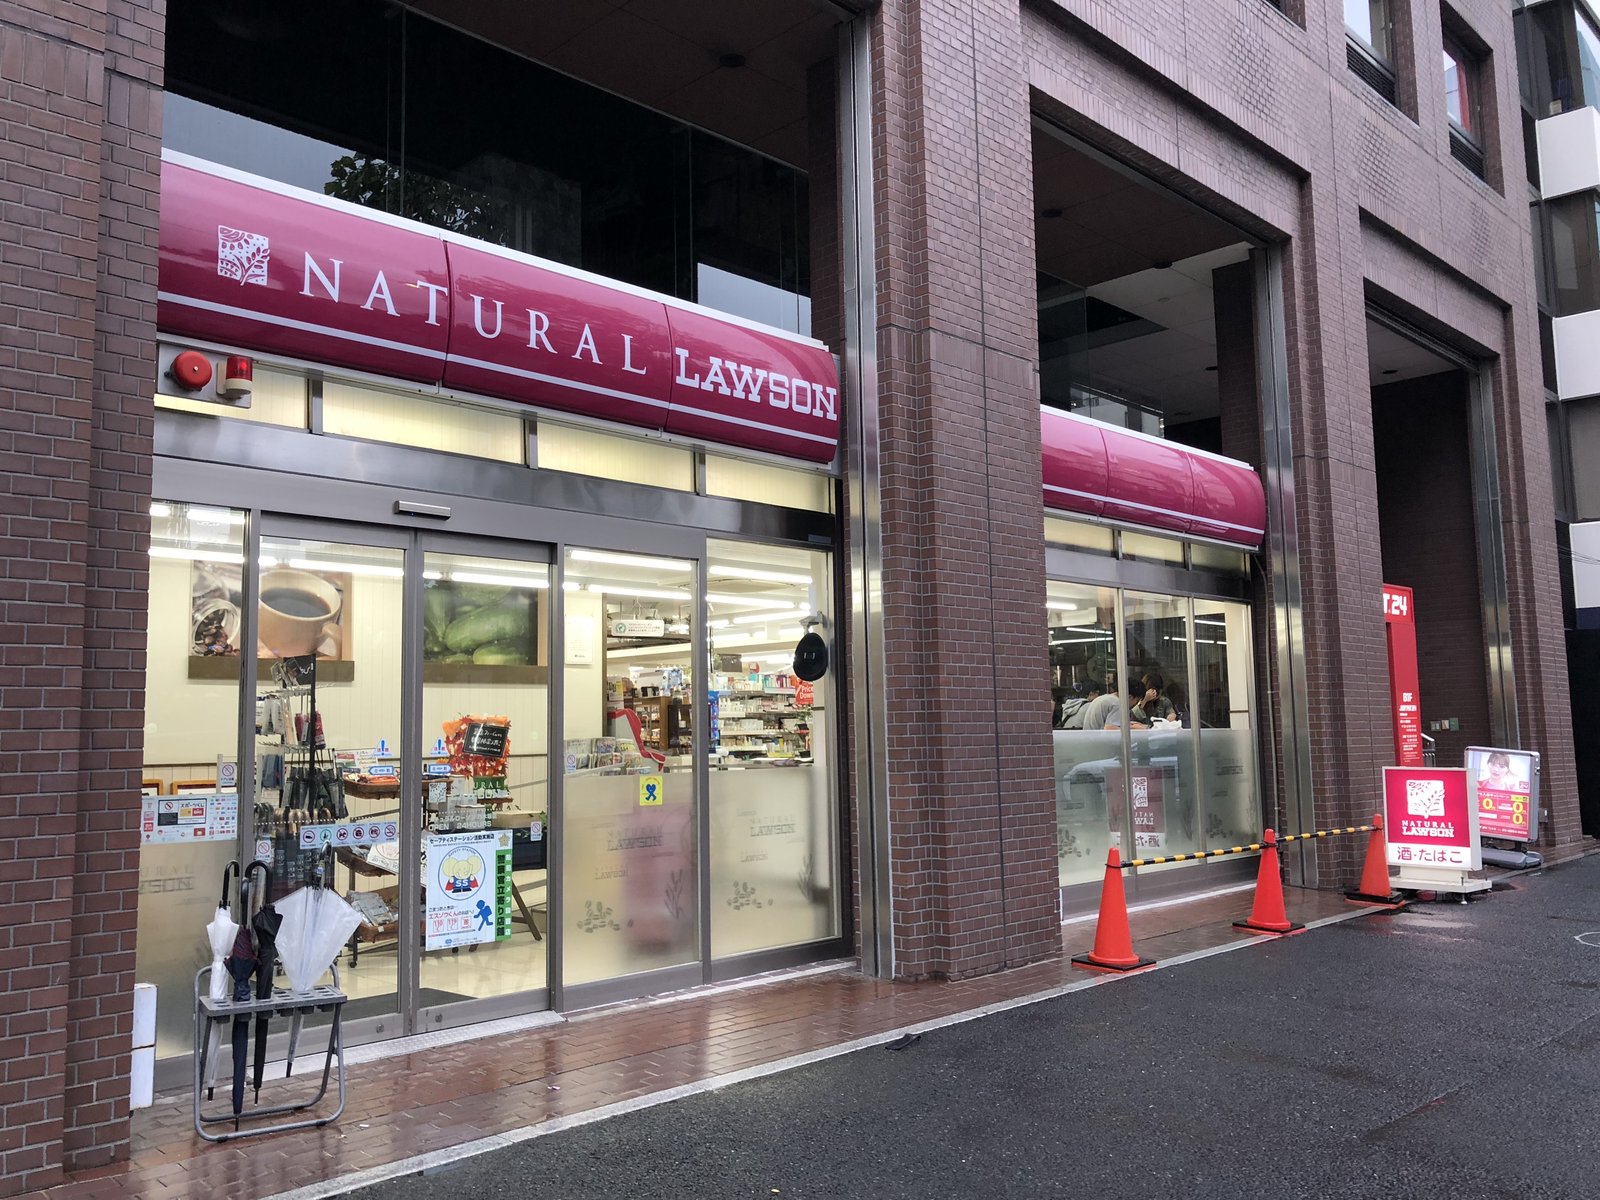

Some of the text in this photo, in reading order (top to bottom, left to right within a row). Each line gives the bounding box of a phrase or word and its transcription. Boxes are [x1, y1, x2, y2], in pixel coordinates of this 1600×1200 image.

[299, 251, 838, 421] NATURAL LAWSON
[1402, 820, 1454, 829] NATURAL
[1402, 826, 1455, 838] LAWSON
